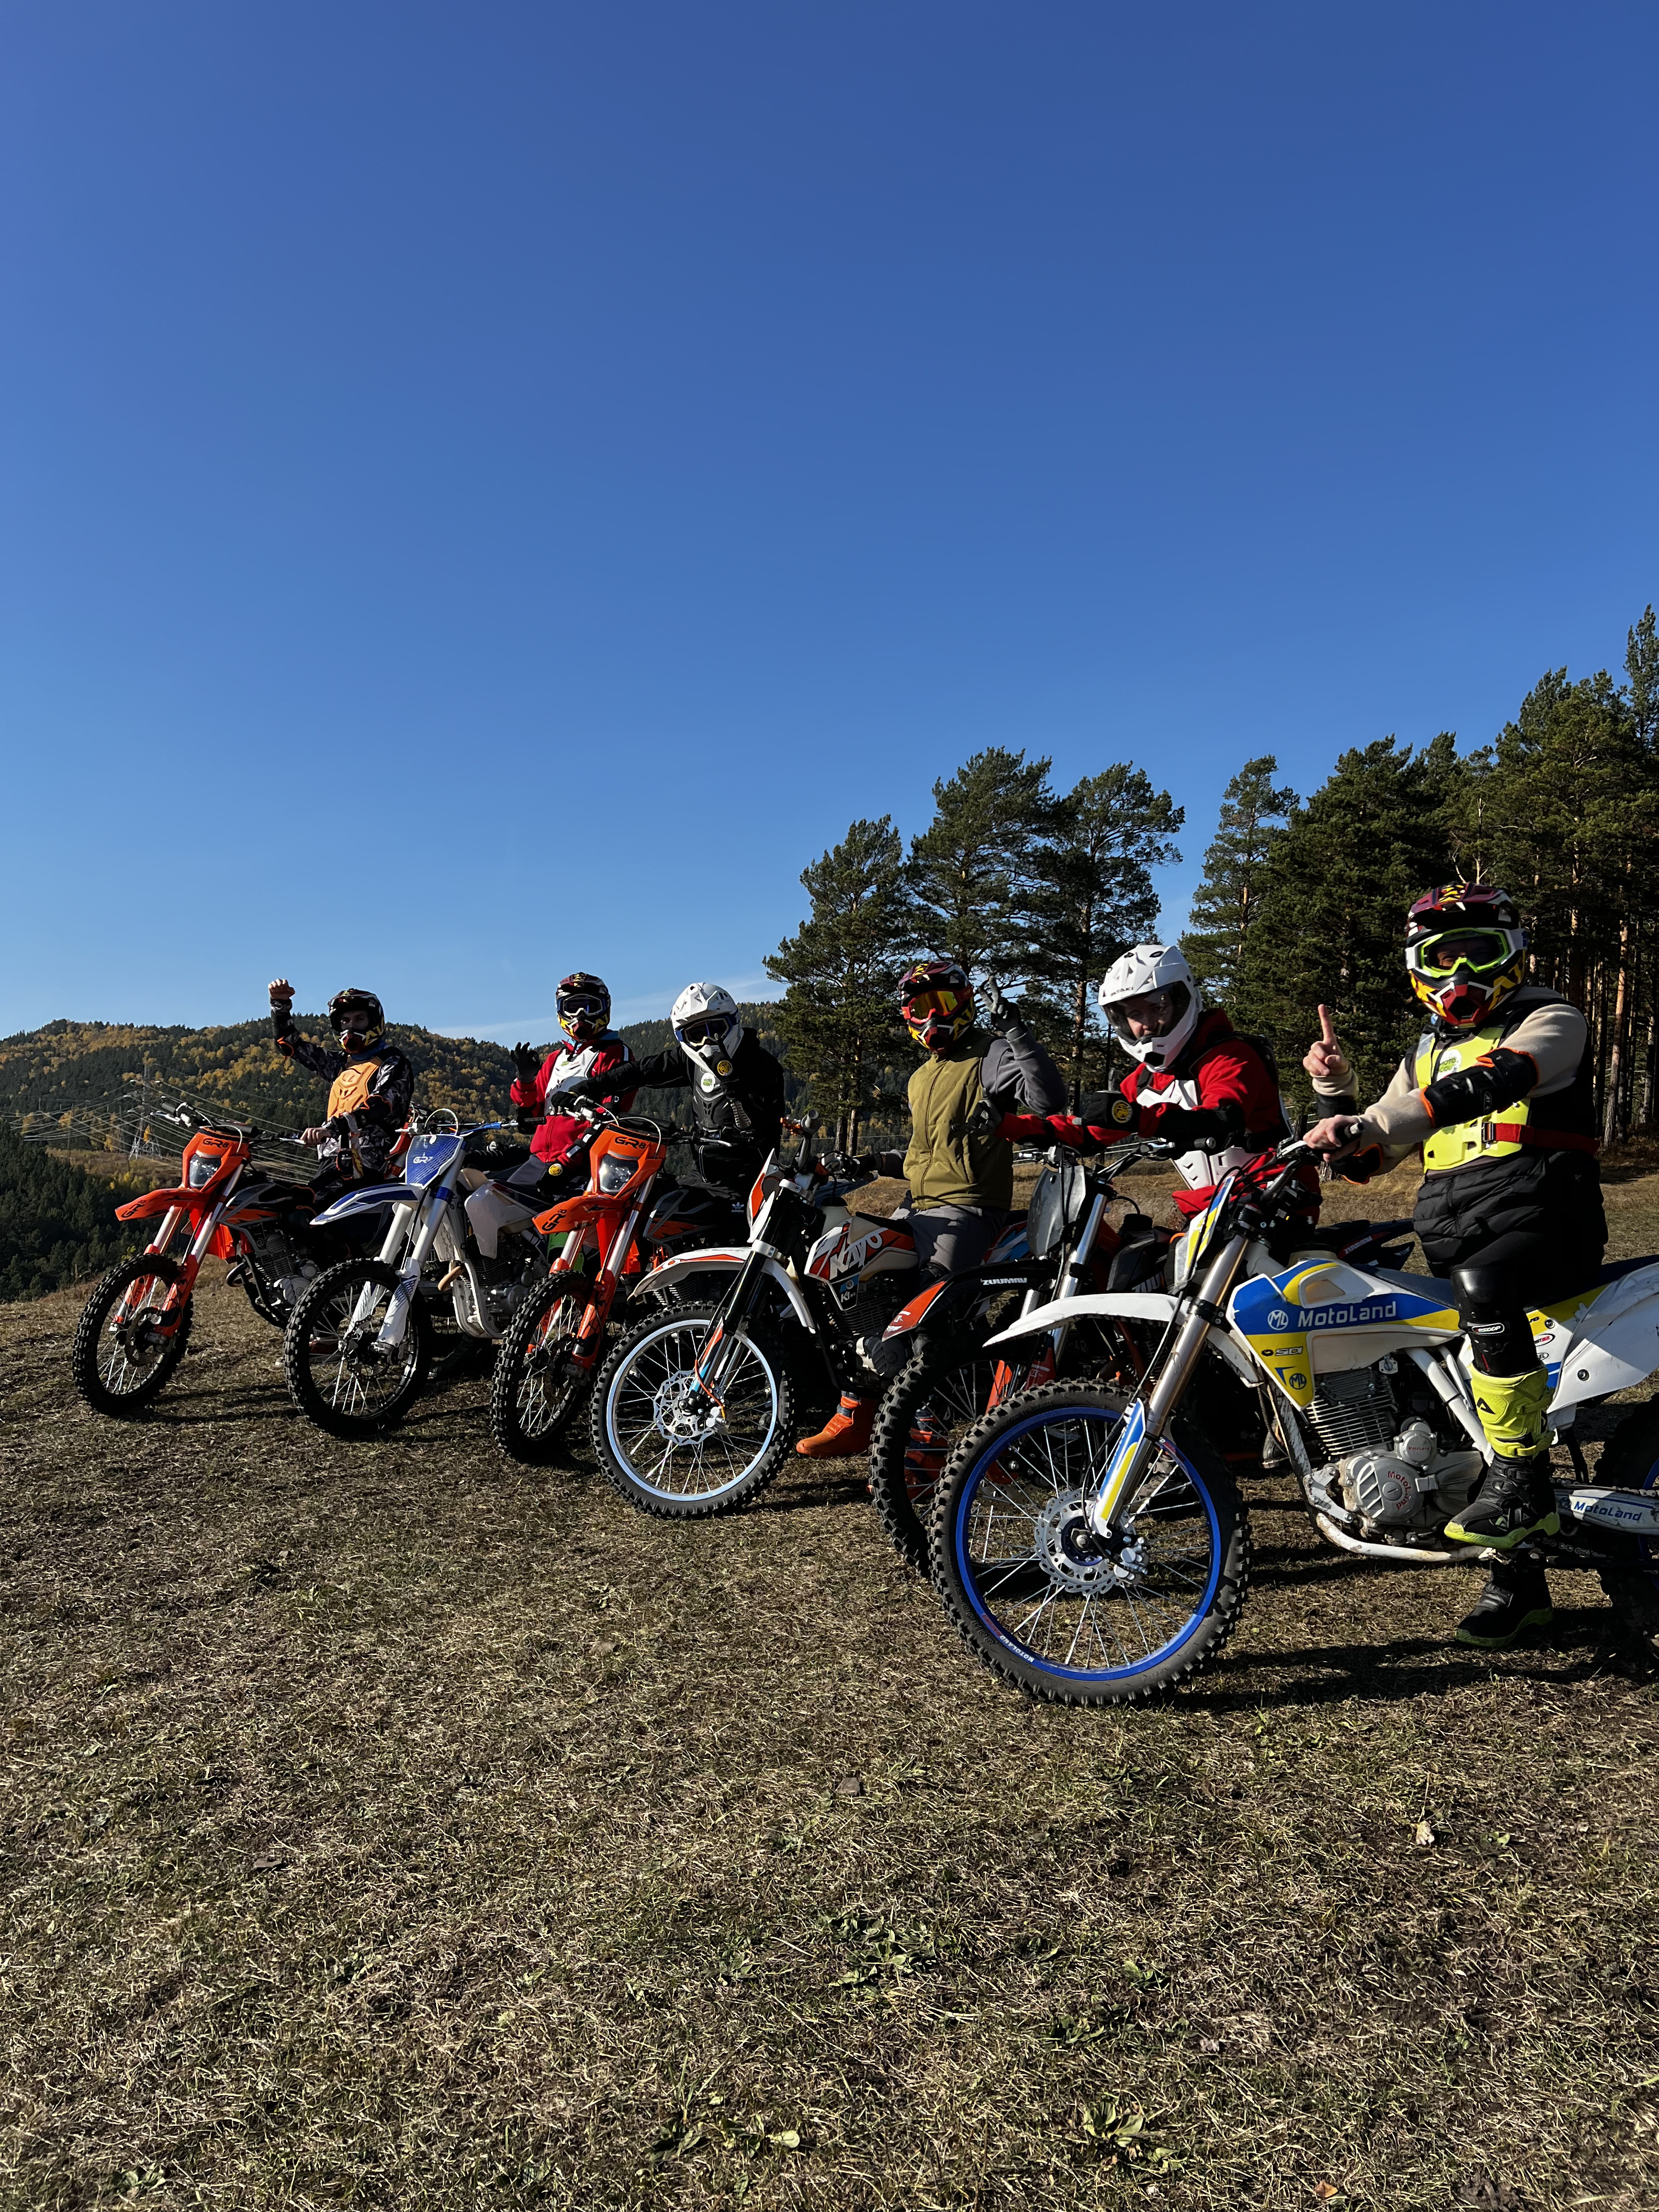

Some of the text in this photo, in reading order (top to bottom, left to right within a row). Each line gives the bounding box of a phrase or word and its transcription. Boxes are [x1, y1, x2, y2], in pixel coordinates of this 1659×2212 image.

[202, 1138, 229, 1148] GR8
[614, 1136, 647, 1149] GR8
[121, 1200, 146, 1218] GR8
[541, 1209, 567, 1231] GR8
[830, 1233, 883, 1280] KAYO
[1297, 1301, 1396, 1328] MotoLand
[1387, 1471, 1412, 1510] MotoLand
[1573, 1501, 1643, 1521] MotoLand
[999, 1635, 1035, 1663] MOTOLAND
